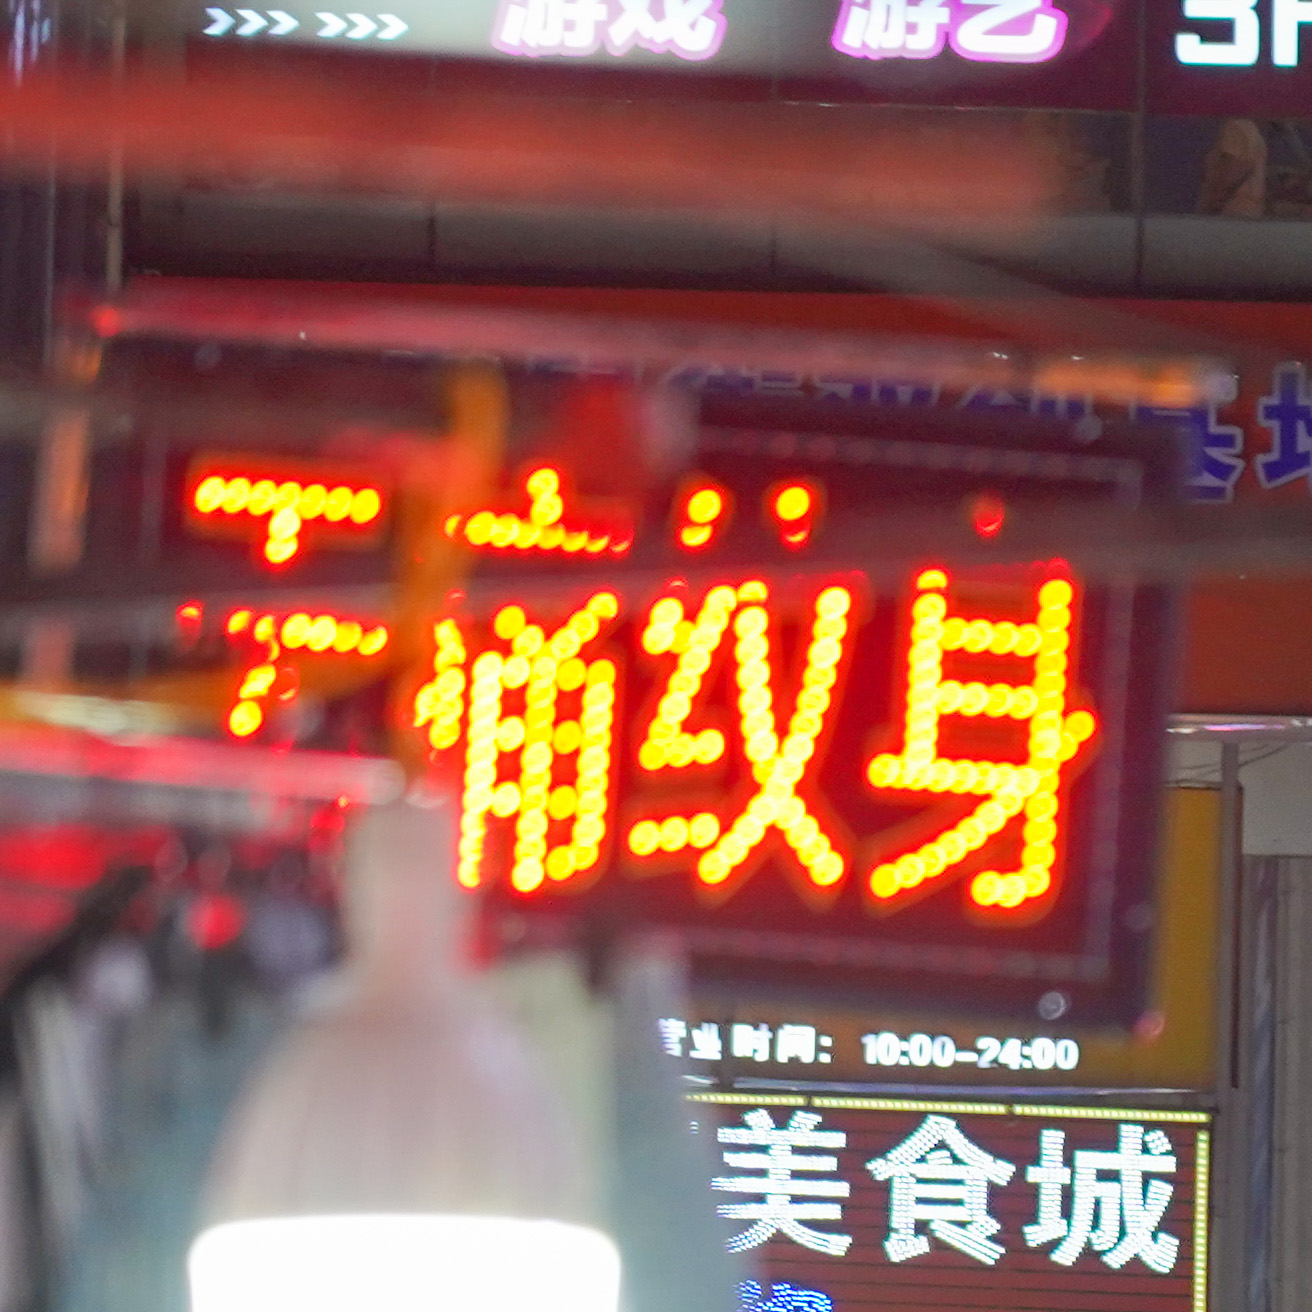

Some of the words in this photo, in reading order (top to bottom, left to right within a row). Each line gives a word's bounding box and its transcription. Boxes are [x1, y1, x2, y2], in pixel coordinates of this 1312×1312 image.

[861, 1031, 1080, 1070] 10:00-24:00
[709, 1108, 1179, 1273] 美食城
